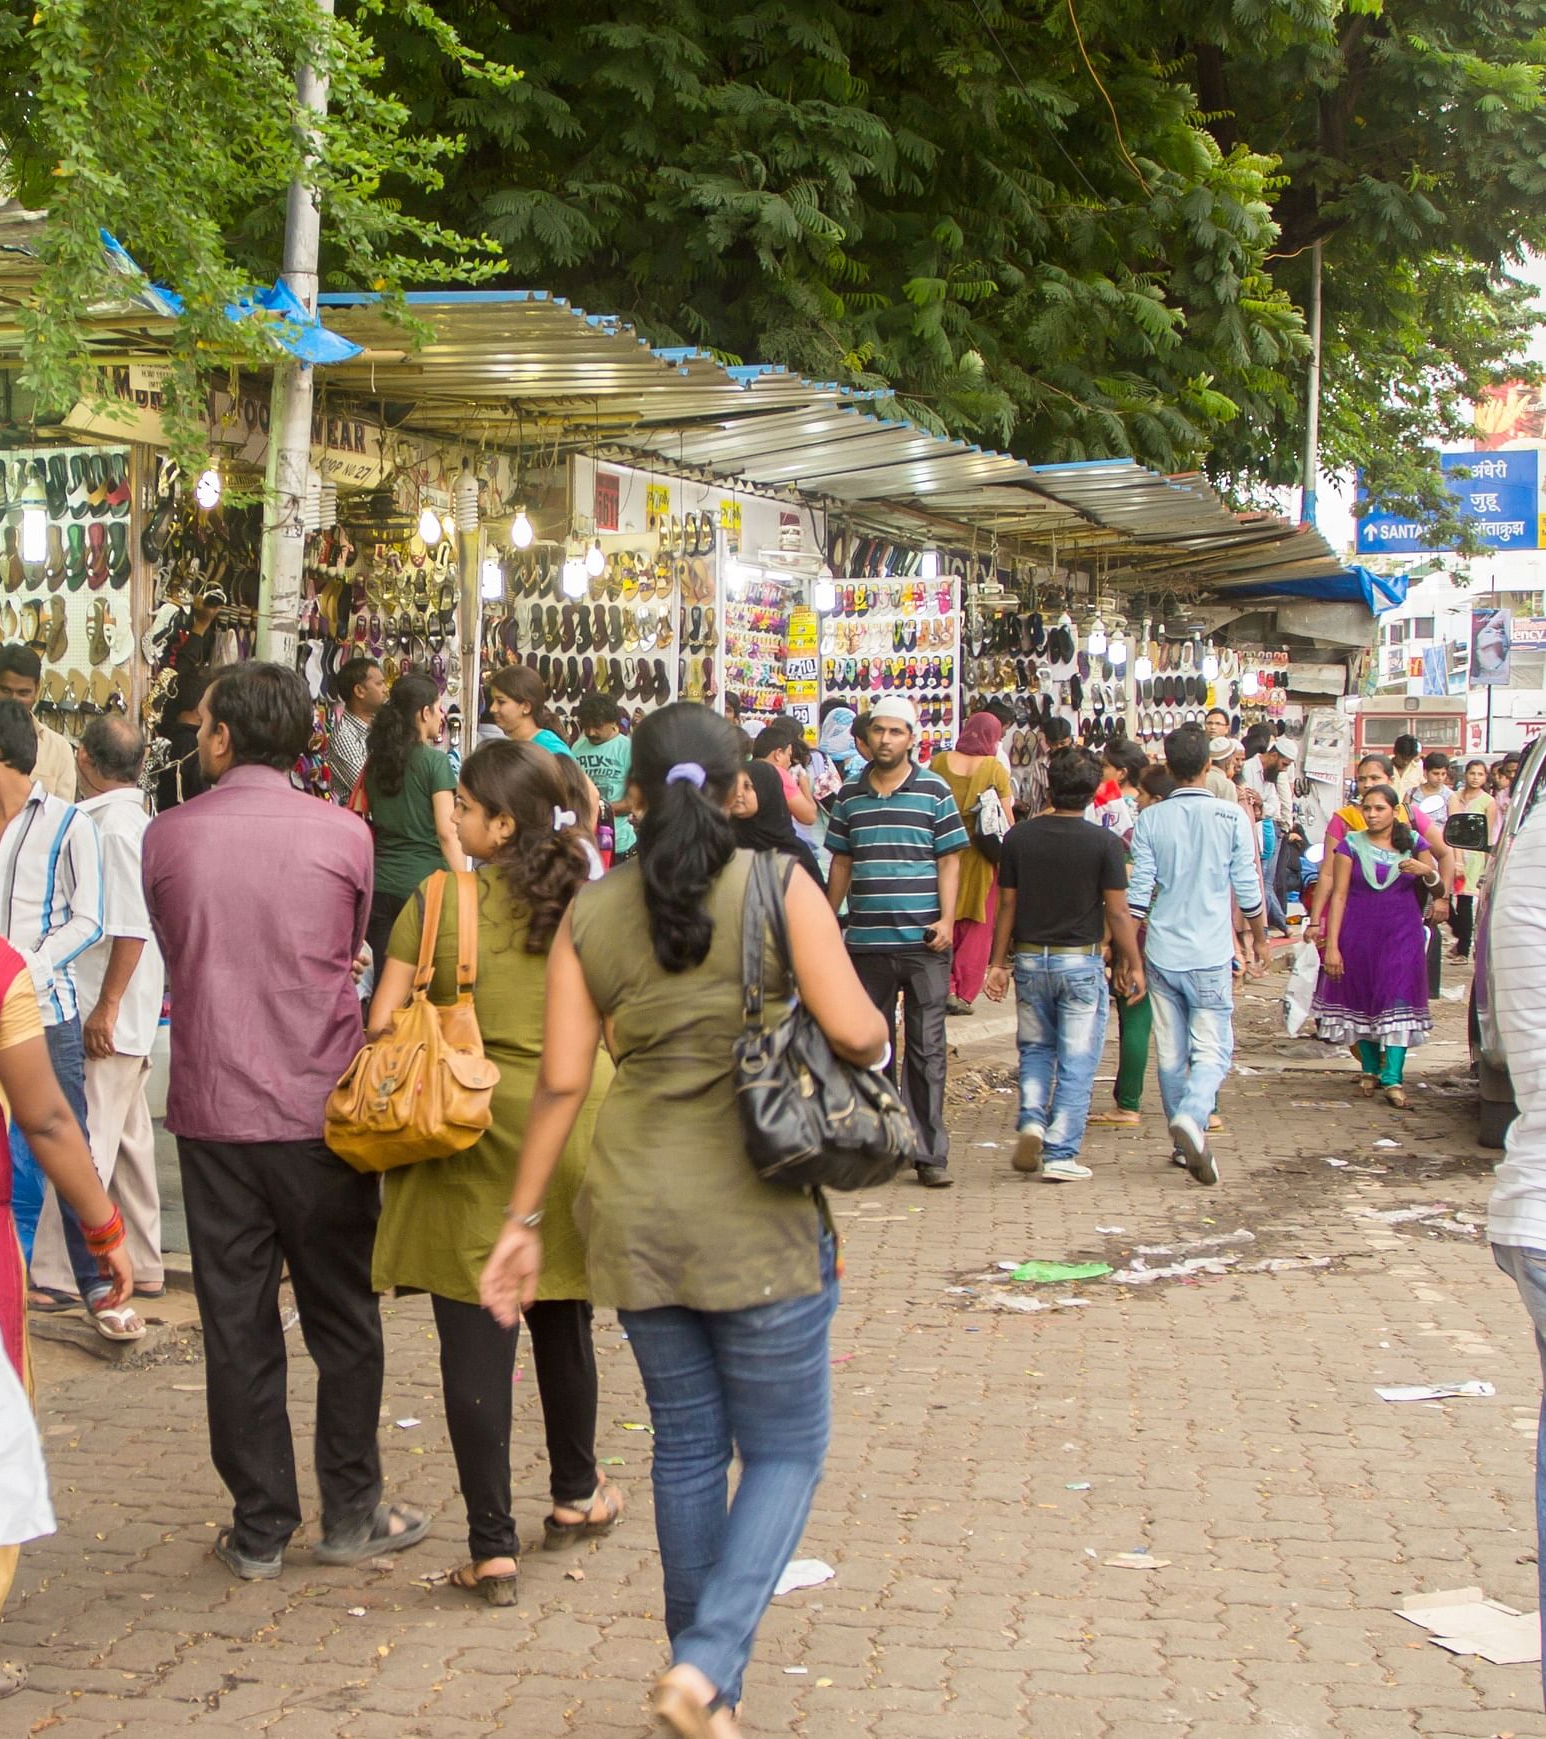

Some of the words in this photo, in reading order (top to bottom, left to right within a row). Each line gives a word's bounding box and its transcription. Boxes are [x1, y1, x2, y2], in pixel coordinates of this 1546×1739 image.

[1470, 493, 1501, 512] जुहू
[1510, 627, 1544, 643] lency
[576, 755, 609, 768] ACK
